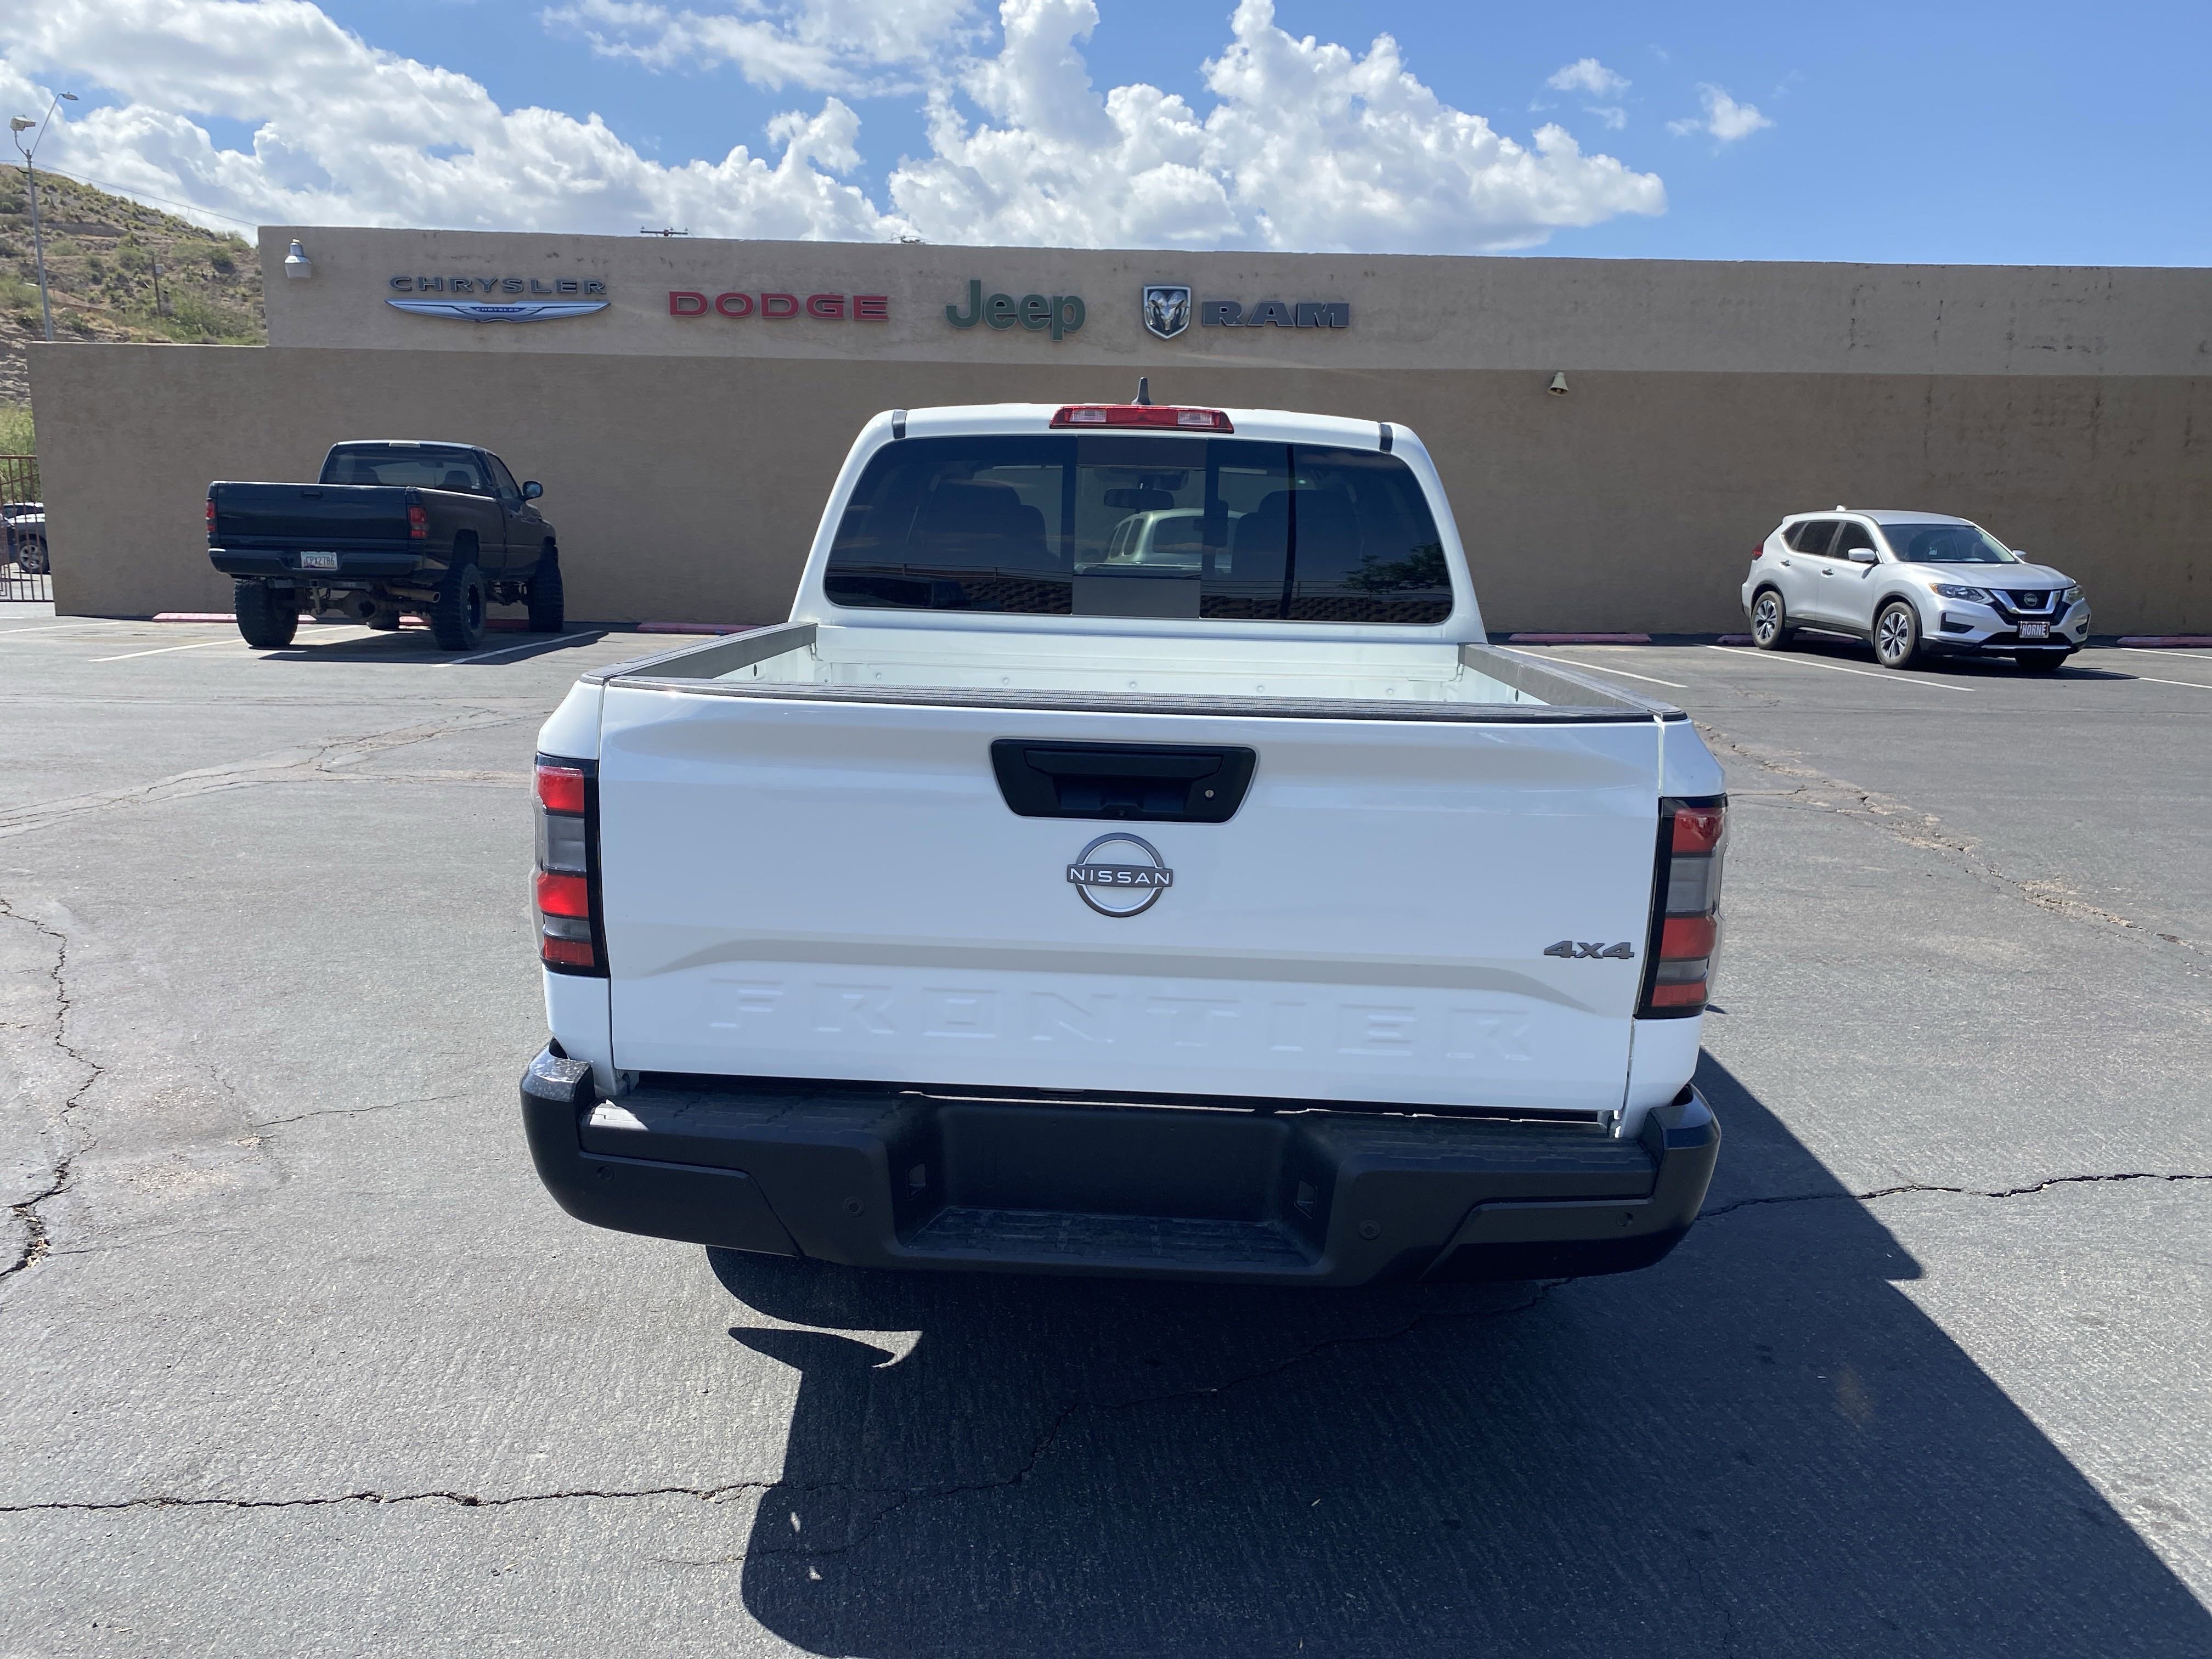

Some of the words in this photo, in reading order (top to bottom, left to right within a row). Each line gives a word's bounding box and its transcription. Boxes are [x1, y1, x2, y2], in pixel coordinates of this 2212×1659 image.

[389, 276, 606, 294] CHRYSLER
[669, 291, 889, 320] DODGE
[945, 279, 1086, 341] Jeep
[1201, 300, 1350, 328] RAM
[2022, 624, 2046, 635] HORNE
[1070, 867, 1170, 884] NISSAN
[708, 978, 1534, 1061] FRONTIER
